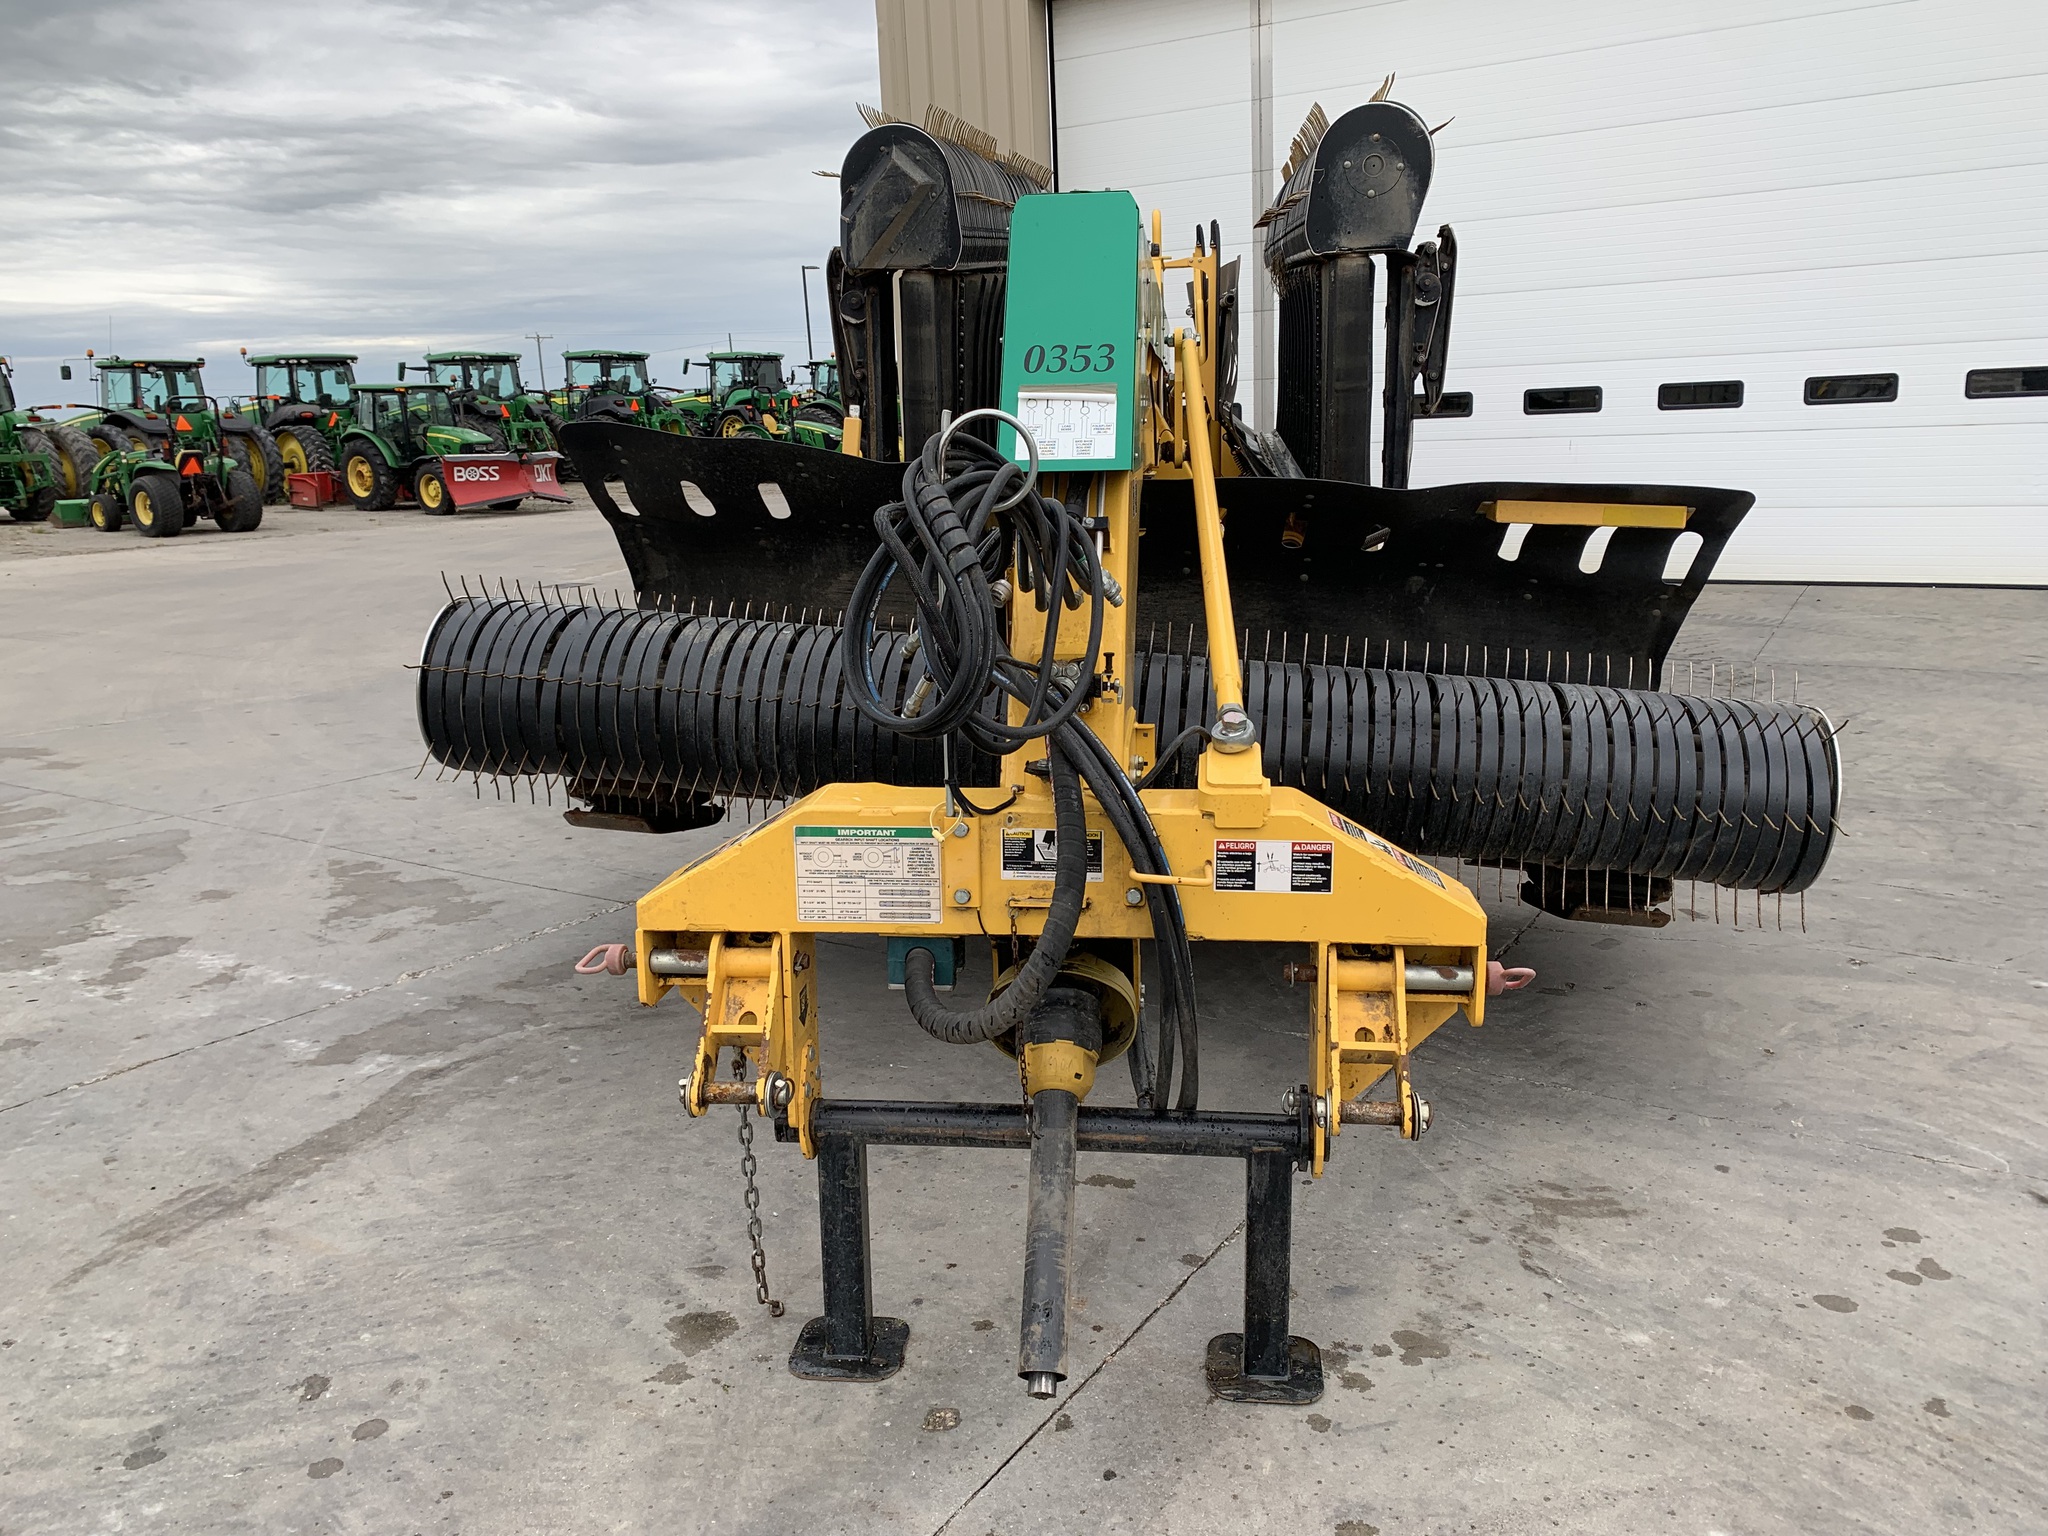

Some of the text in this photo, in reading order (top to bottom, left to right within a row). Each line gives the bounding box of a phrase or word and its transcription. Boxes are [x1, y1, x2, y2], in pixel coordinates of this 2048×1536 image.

[1024, 343, 1115, 374] 0353
[453, 463, 552, 483] BOSS DXT
[1225, 842, 1255, 850] PELIGRO
[1301, 843, 1331, 851] DANGER
